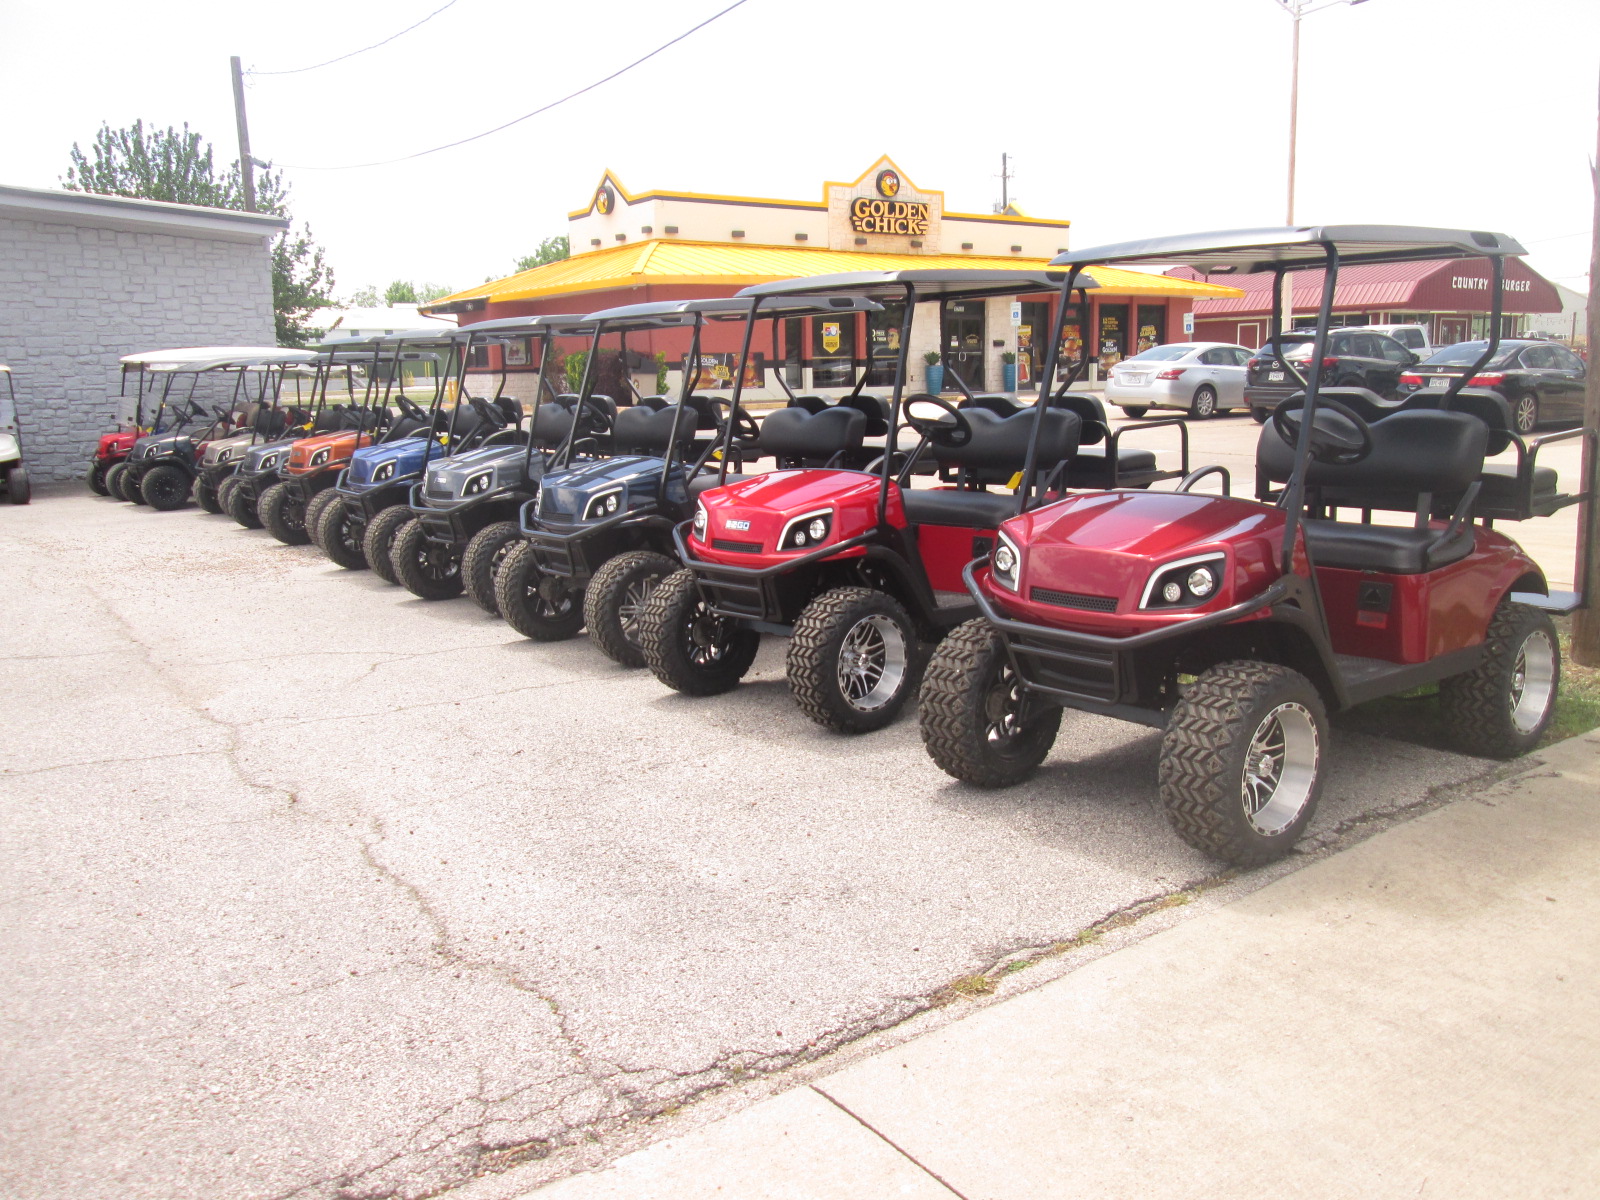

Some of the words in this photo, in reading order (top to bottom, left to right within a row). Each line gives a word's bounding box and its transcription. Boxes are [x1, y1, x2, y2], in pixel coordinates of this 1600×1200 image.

[854, 198, 930, 222] GOLDEN
[861, 217, 922, 235] CHICK
[1452, 276, 1489, 290] COUNTRY
